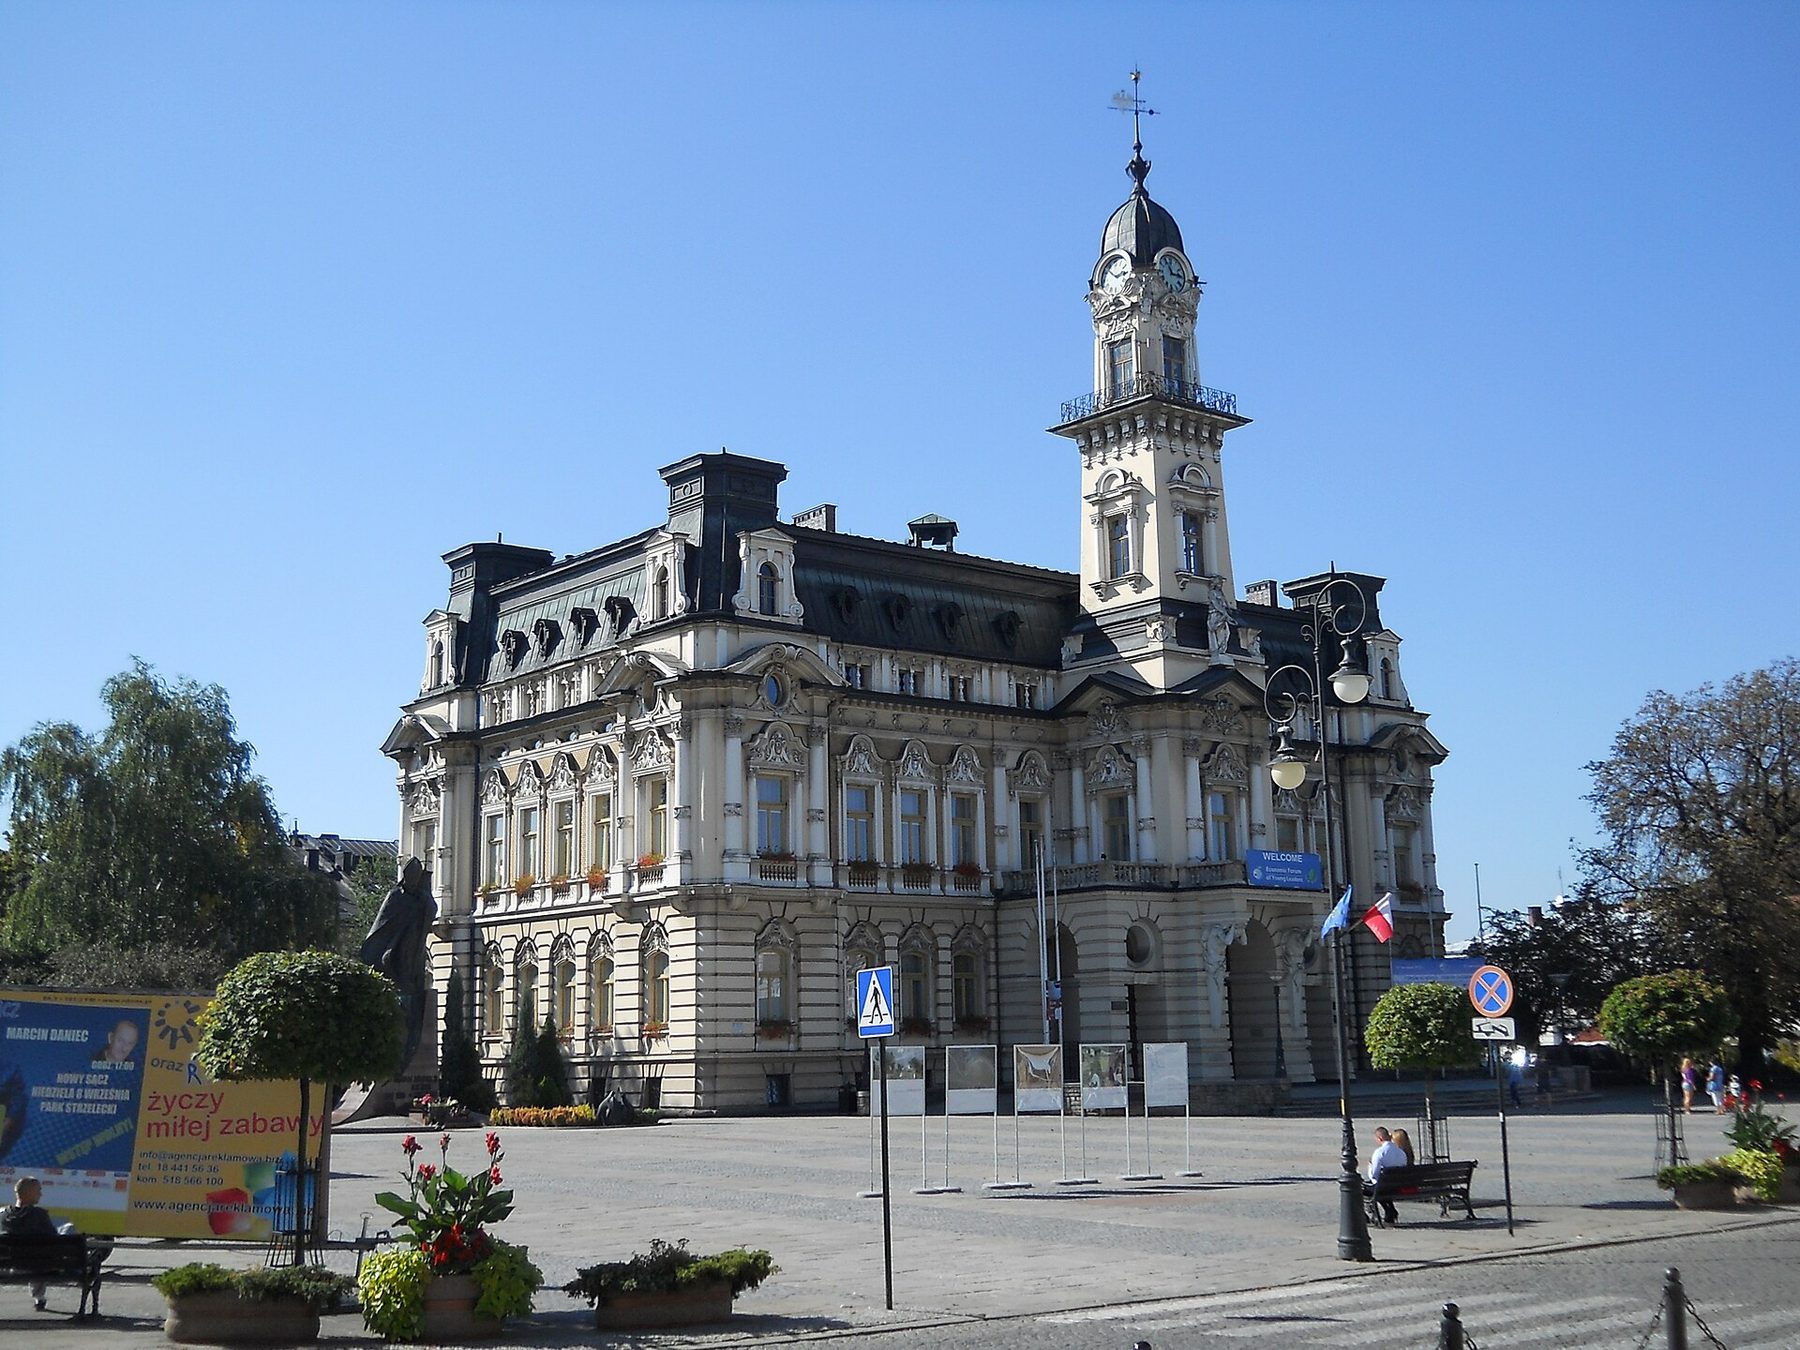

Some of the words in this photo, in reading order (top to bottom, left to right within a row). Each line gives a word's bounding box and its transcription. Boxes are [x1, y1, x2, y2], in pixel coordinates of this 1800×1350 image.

[1262, 852, 1303, 863] WELCOME
[6, 1027, 48, 1040] MARCIN
[50, 1029, 89, 1042] DANIEC
[151, 1057, 184, 1073] oraz
[56, 1073, 85, 1085] NOWY
[86, 1074, 109, 1086] SĄCZ
[31, 1086, 75, 1099] NIEDZIELA
[84, 1088, 130, 1101] WRZEŚNIA
[40, 1101, 64, 1113] PARK
[65, 1102, 118, 1115] STRZELECKI
[147, 1090, 225, 1115] życzy
[146, 1114, 211, 1142] miłej
[219, 1111, 326, 1137] zabawy
[158, 1163, 169, 1172] 18
[170, 1164, 188, 1172] 441
[206, 1164, 219, 1173] 36
[162, 1176, 181, 1185] 518
[206, 1177, 224, 1186] 100
